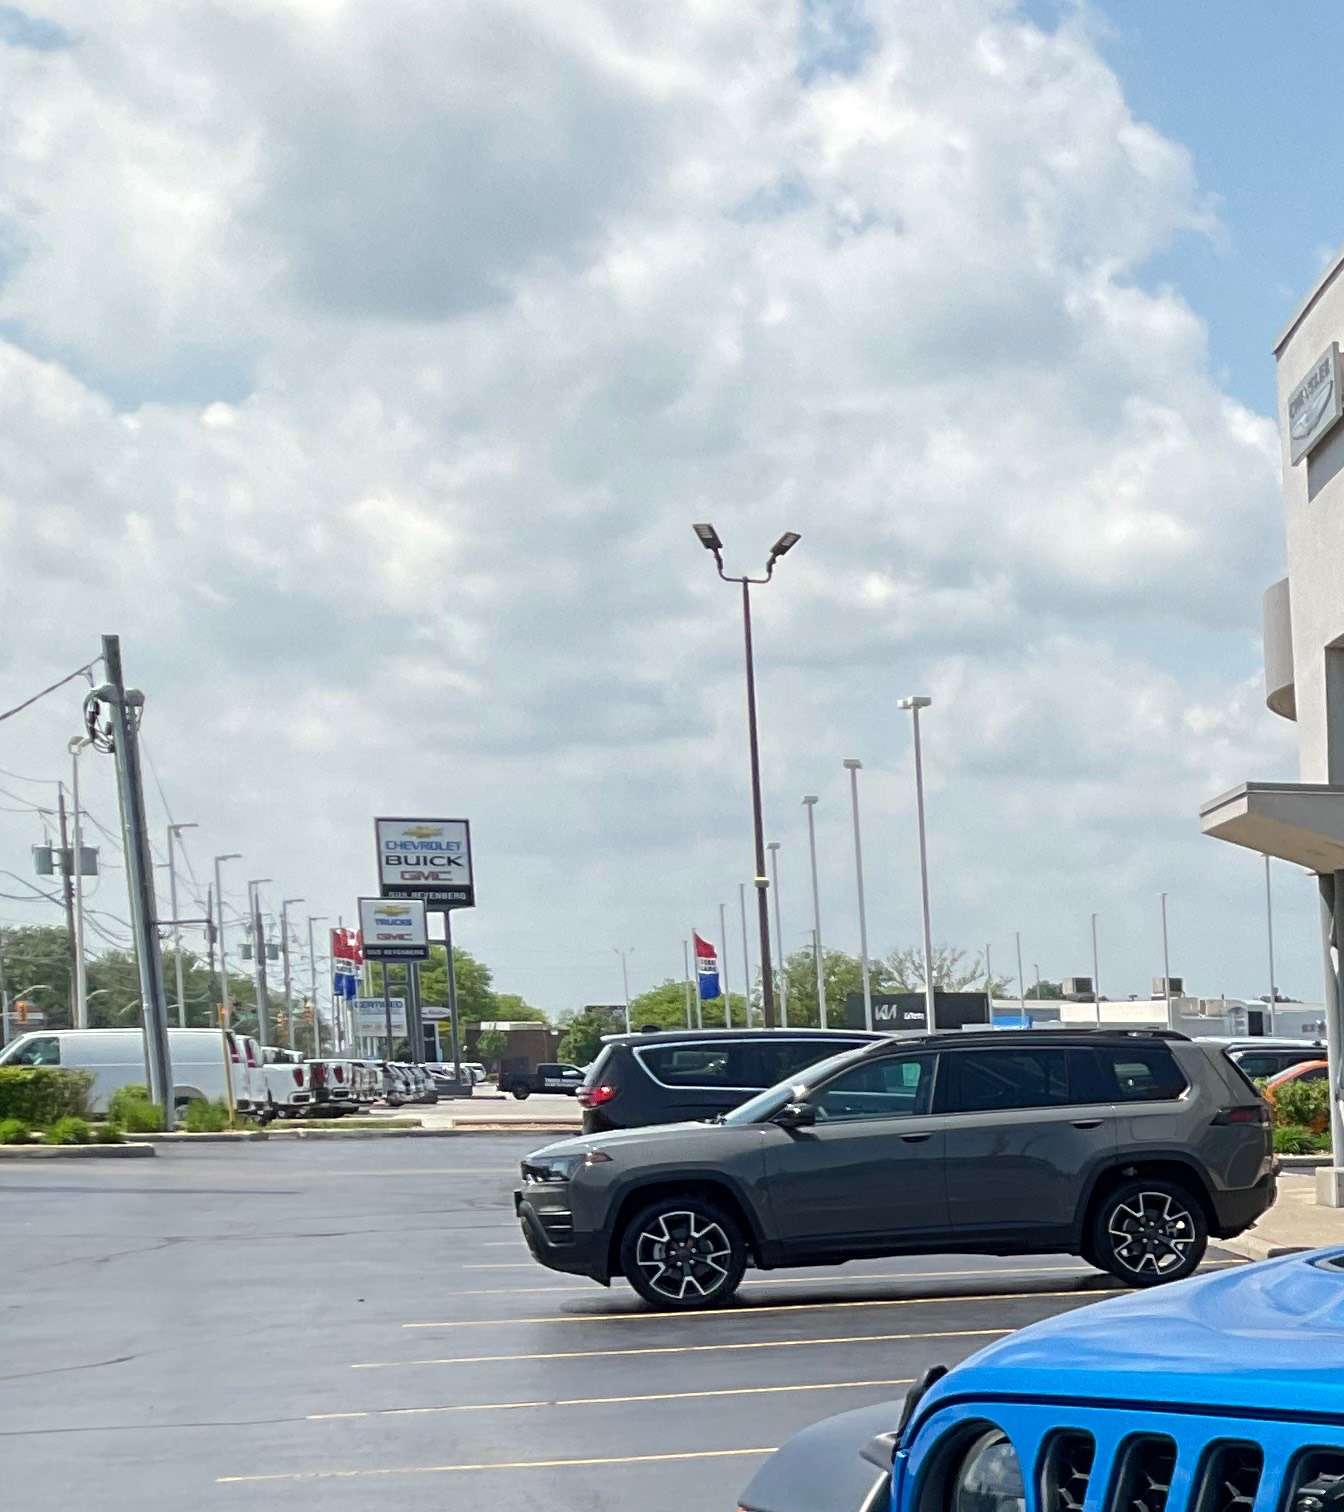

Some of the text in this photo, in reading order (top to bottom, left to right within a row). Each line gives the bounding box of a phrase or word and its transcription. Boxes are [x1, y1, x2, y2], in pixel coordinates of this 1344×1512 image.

[384, 840, 462, 851] CHEVROLET
[385, 855, 464, 867] BUICK
[400, 870, 453, 881] GMC
[374, 918, 413, 926] TRUCKS
[376, 933, 413, 941] GMC
